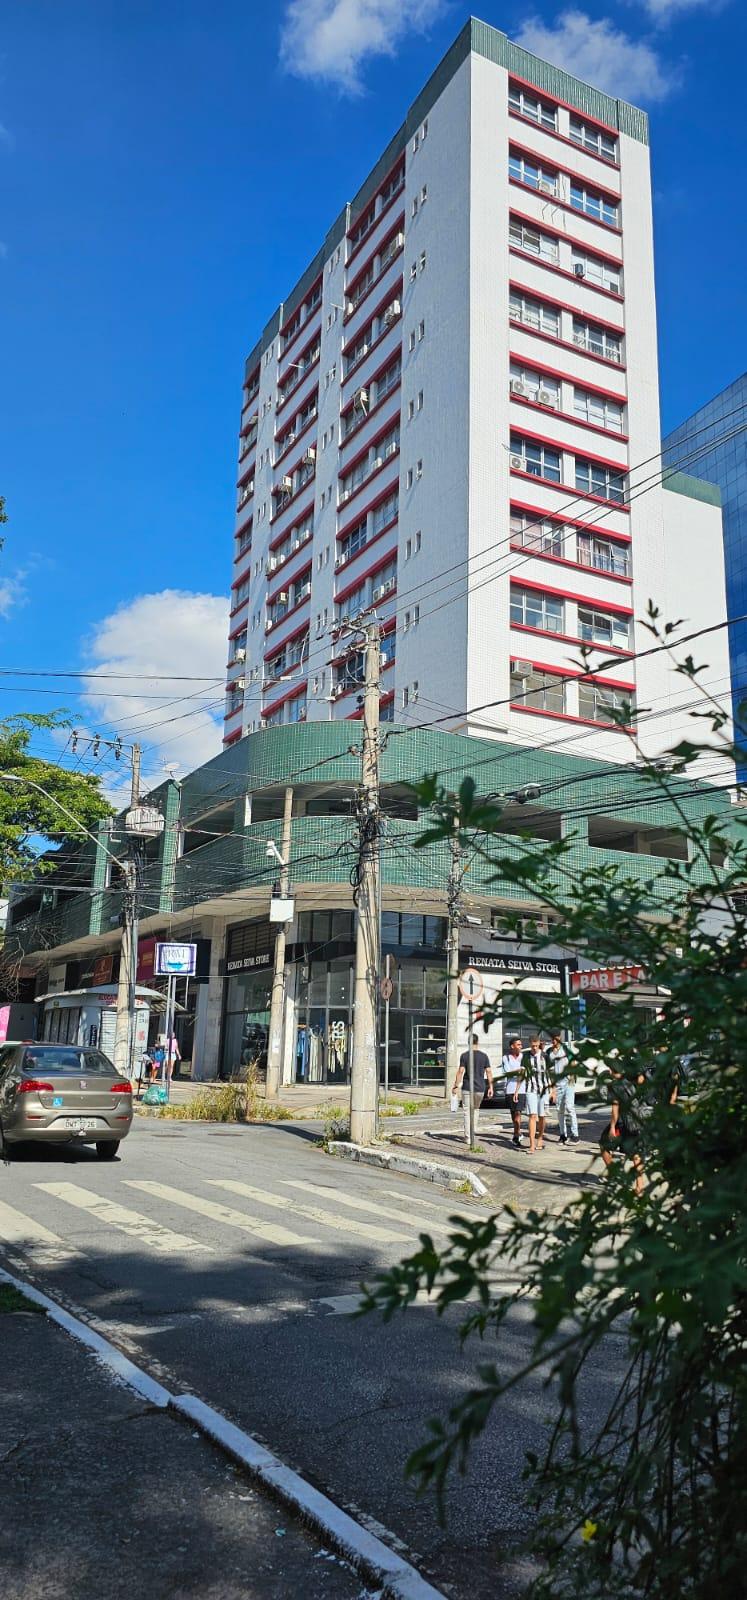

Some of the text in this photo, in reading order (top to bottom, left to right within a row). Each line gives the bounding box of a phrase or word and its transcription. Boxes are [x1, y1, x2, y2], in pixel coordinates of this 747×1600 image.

[468, 956, 506, 969] RENATA
[580, 973, 609, 990] BAR
[613, 971, 622, 988] E
